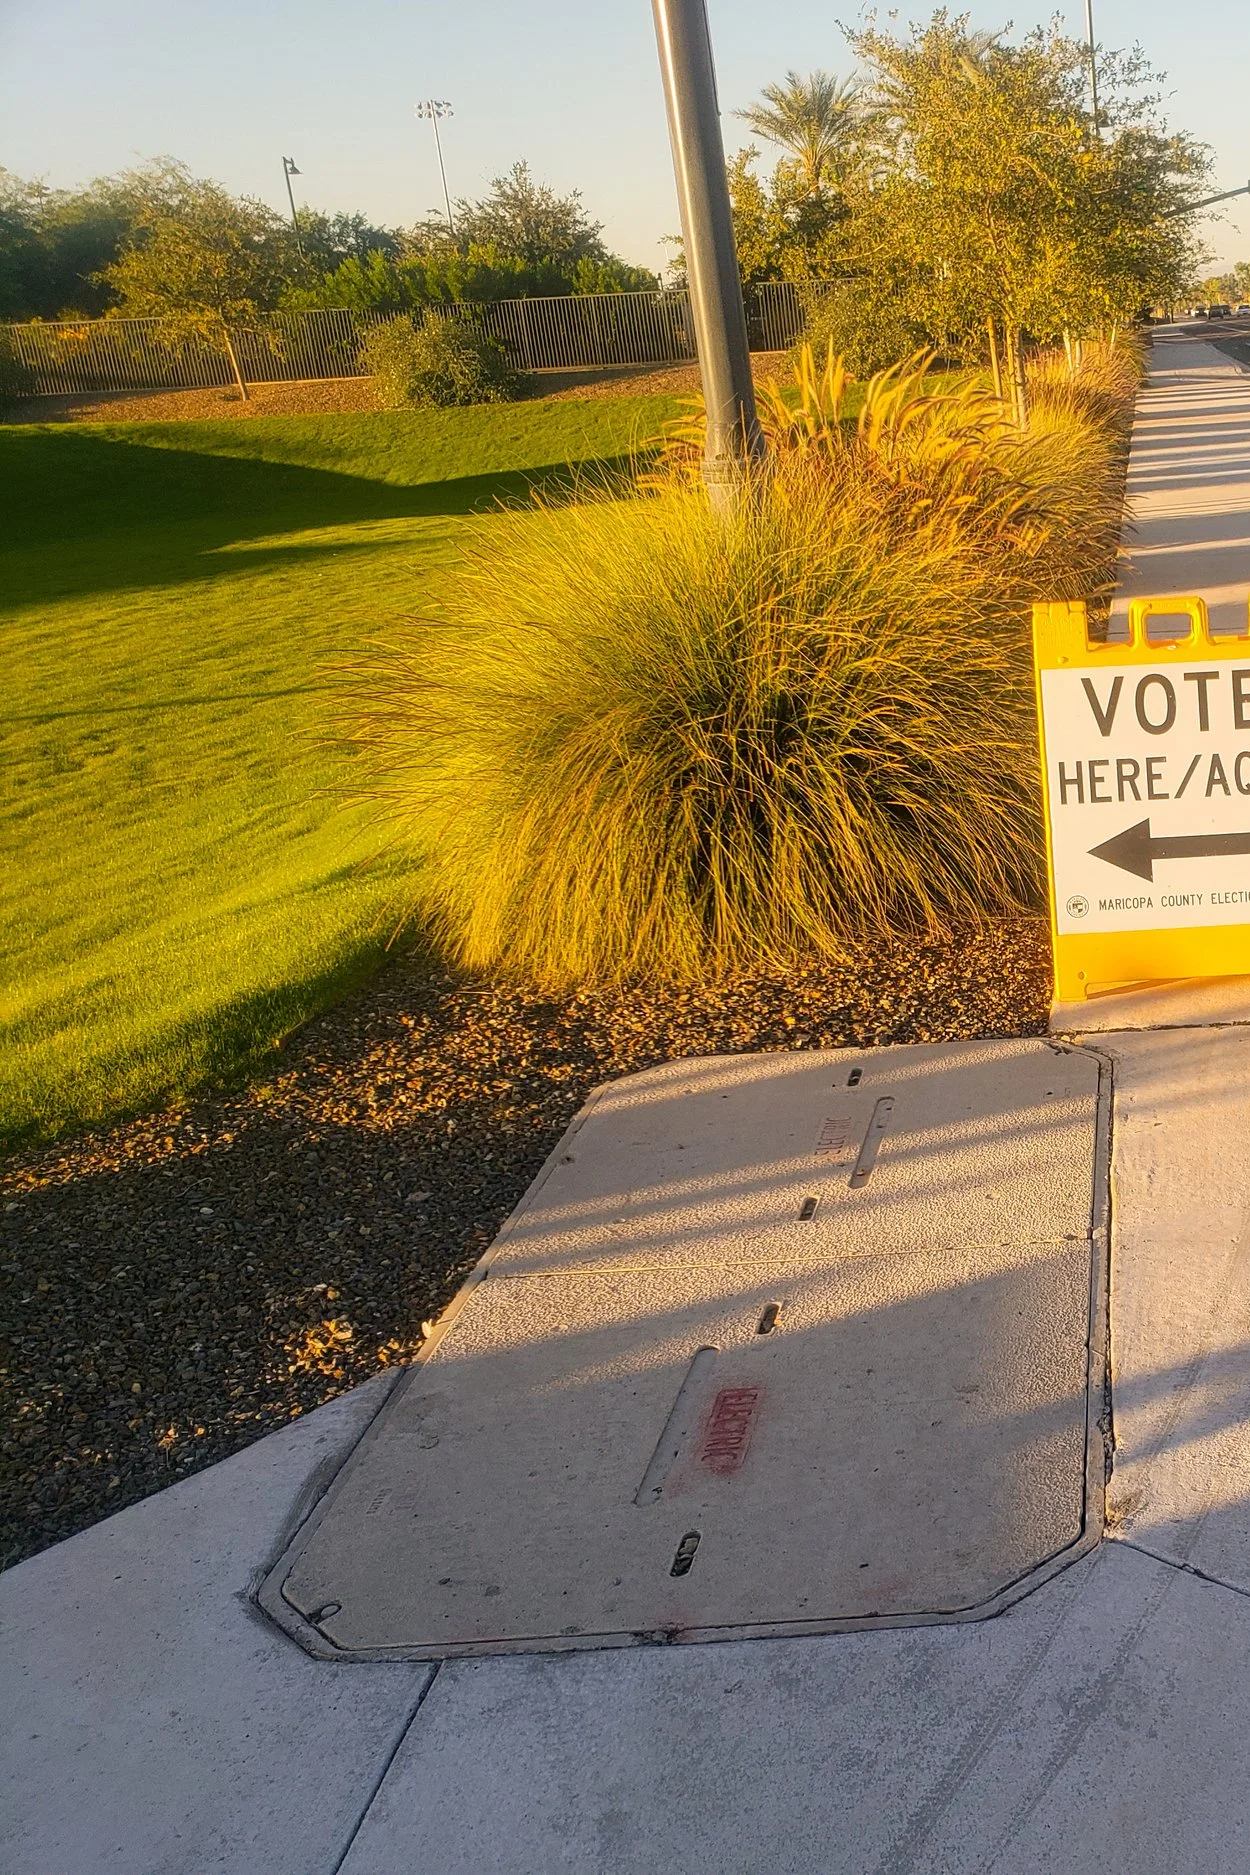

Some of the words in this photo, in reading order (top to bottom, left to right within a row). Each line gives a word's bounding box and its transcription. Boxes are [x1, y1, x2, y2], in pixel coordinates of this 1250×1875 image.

[1099, 897, 1154, 911] MARICOPA
[1161, 893, 1203, 908] COUNTY
[701, 1391, 759, 1463] ELECTRIC
